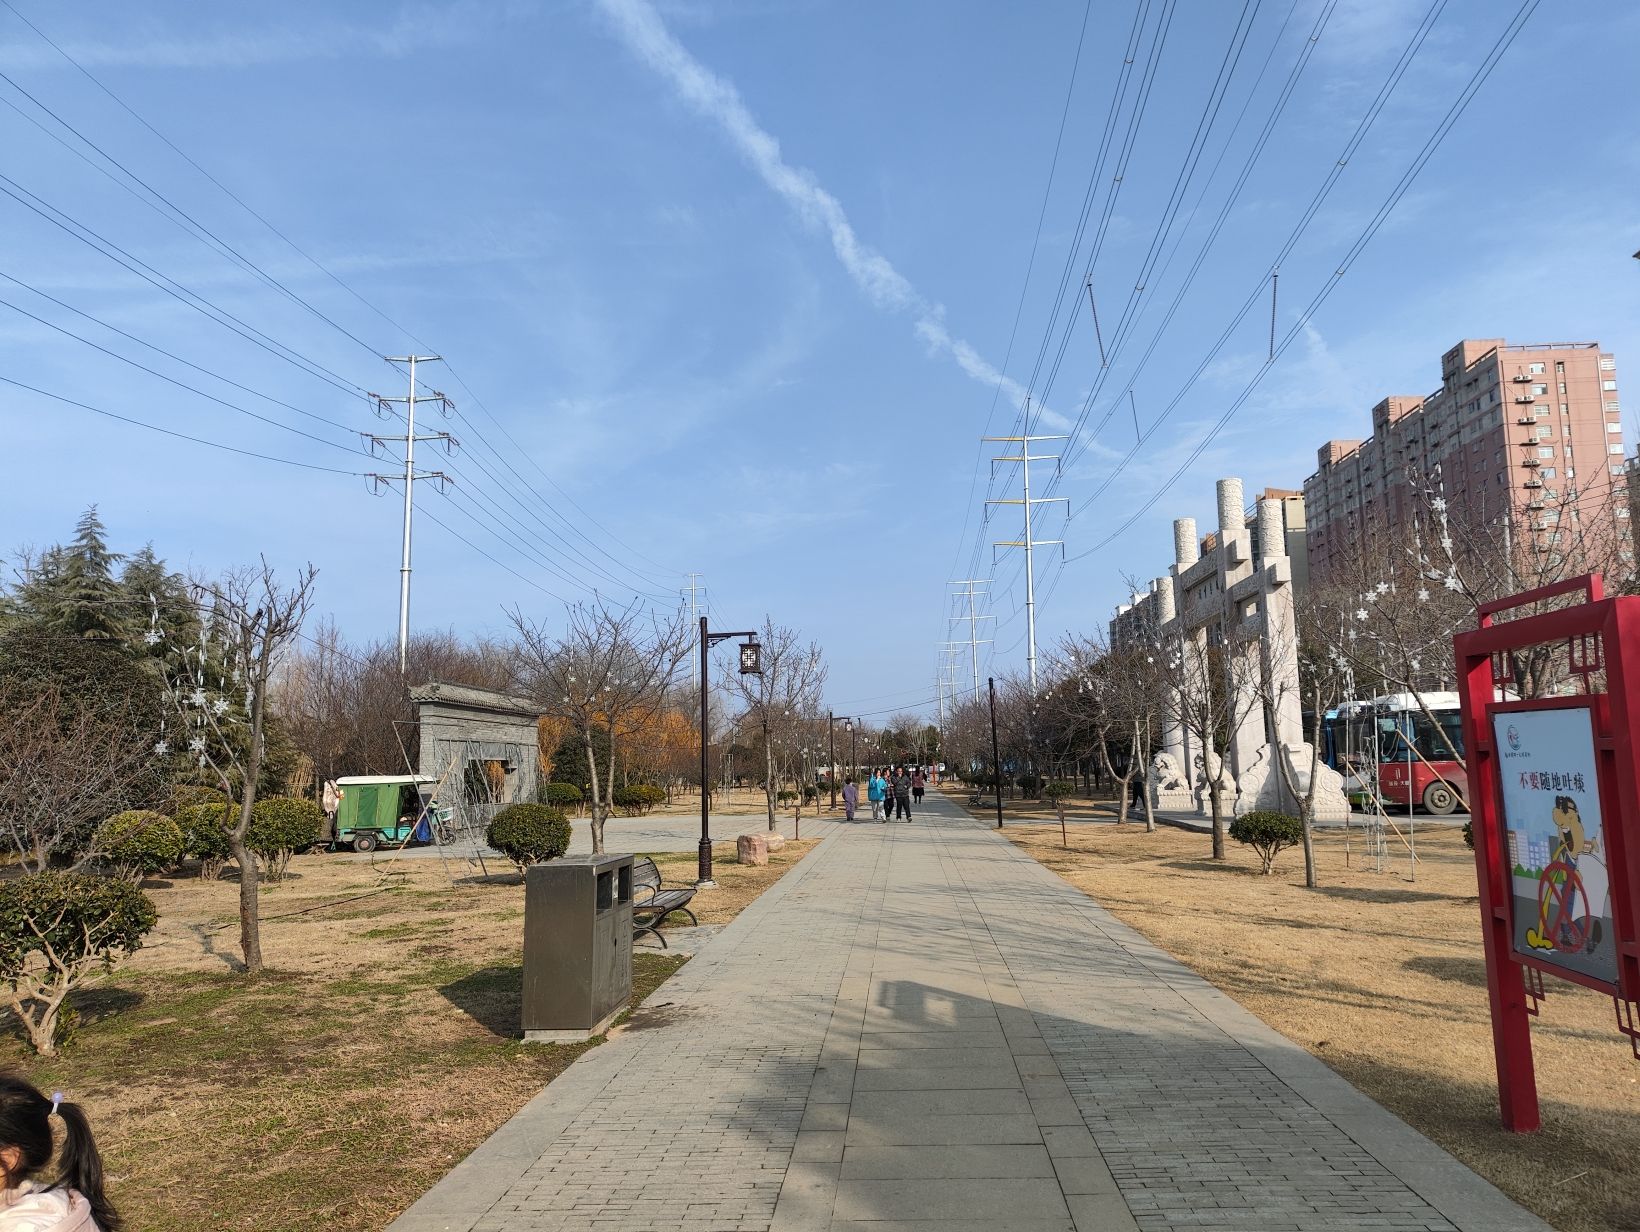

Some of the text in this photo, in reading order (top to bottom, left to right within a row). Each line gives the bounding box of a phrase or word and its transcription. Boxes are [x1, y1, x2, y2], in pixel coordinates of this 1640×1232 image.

[1519, 771, 1585, 793] 不要随地吐痰
